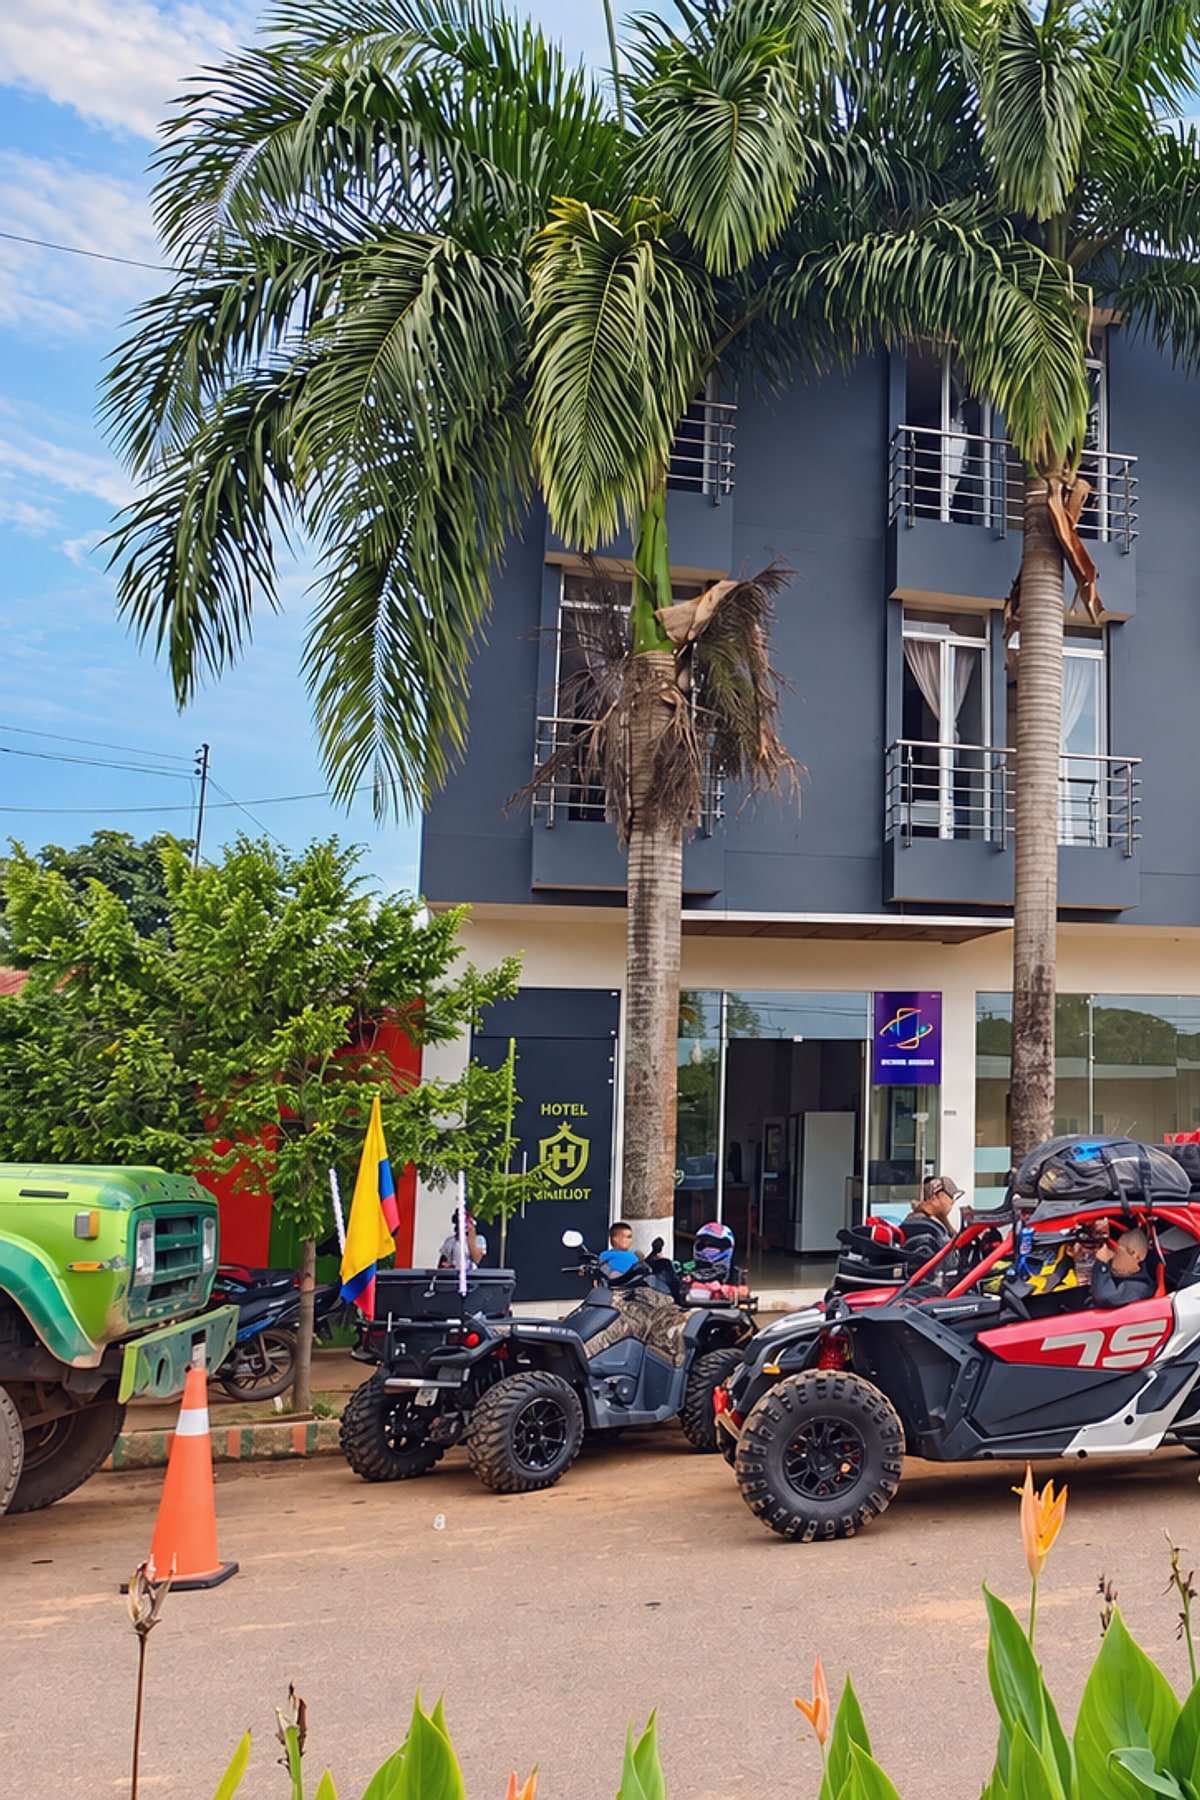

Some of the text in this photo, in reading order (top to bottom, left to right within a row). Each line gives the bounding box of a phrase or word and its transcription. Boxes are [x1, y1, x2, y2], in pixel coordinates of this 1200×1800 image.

[541, 1104, 588, 1116] HOTEL
[552, 1145, 576, 1170] H
[1040, 1318, 1168, 1368] 75
